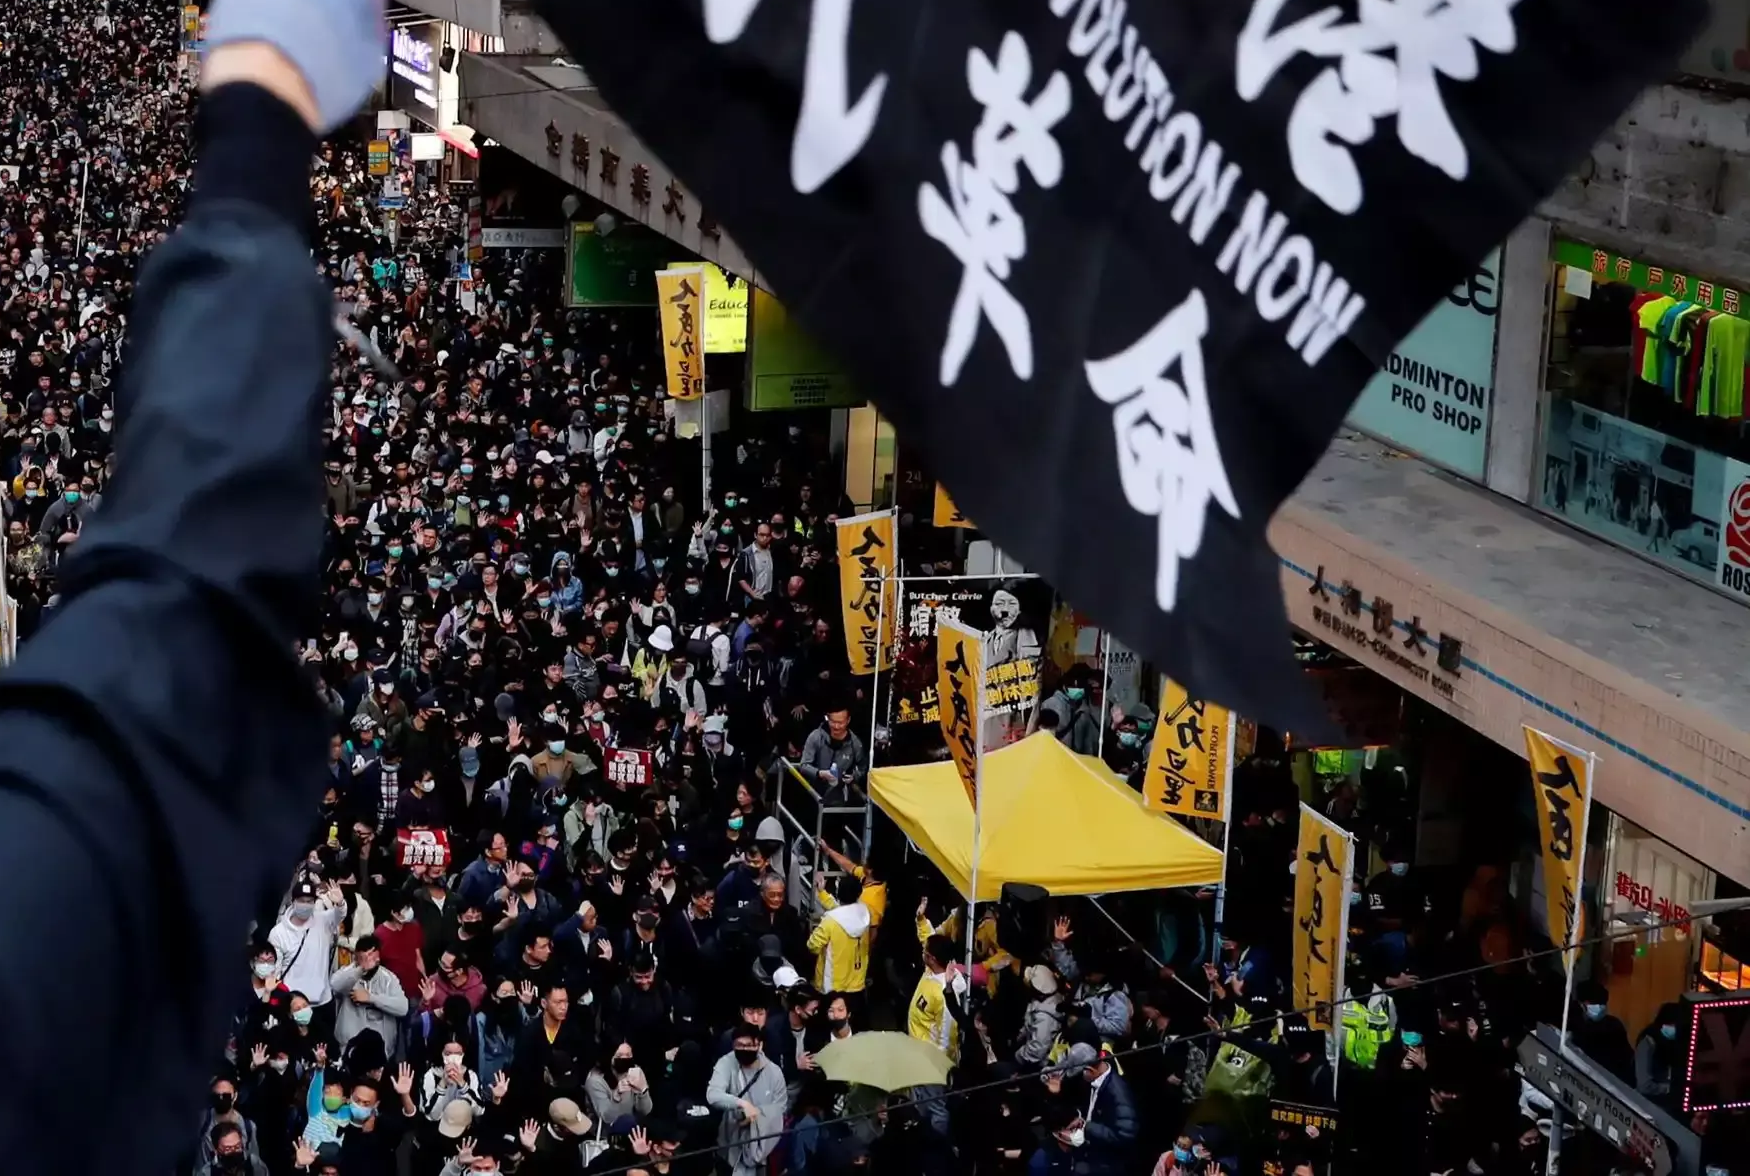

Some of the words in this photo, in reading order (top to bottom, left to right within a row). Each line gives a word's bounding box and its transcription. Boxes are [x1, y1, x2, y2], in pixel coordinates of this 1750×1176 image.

[1219, 197, 1365, 368] NOW
[1593, 249, 1631, 280] 旅行
[1648, 267, 1740, 314] 戶外用品
[1391, 383, 1426, 415] PRO
[1433, 404, 1482, 436] SHOP
[909, 591, 948, 601] Butcher
[1603, 1098, 1632, 1127] Road
